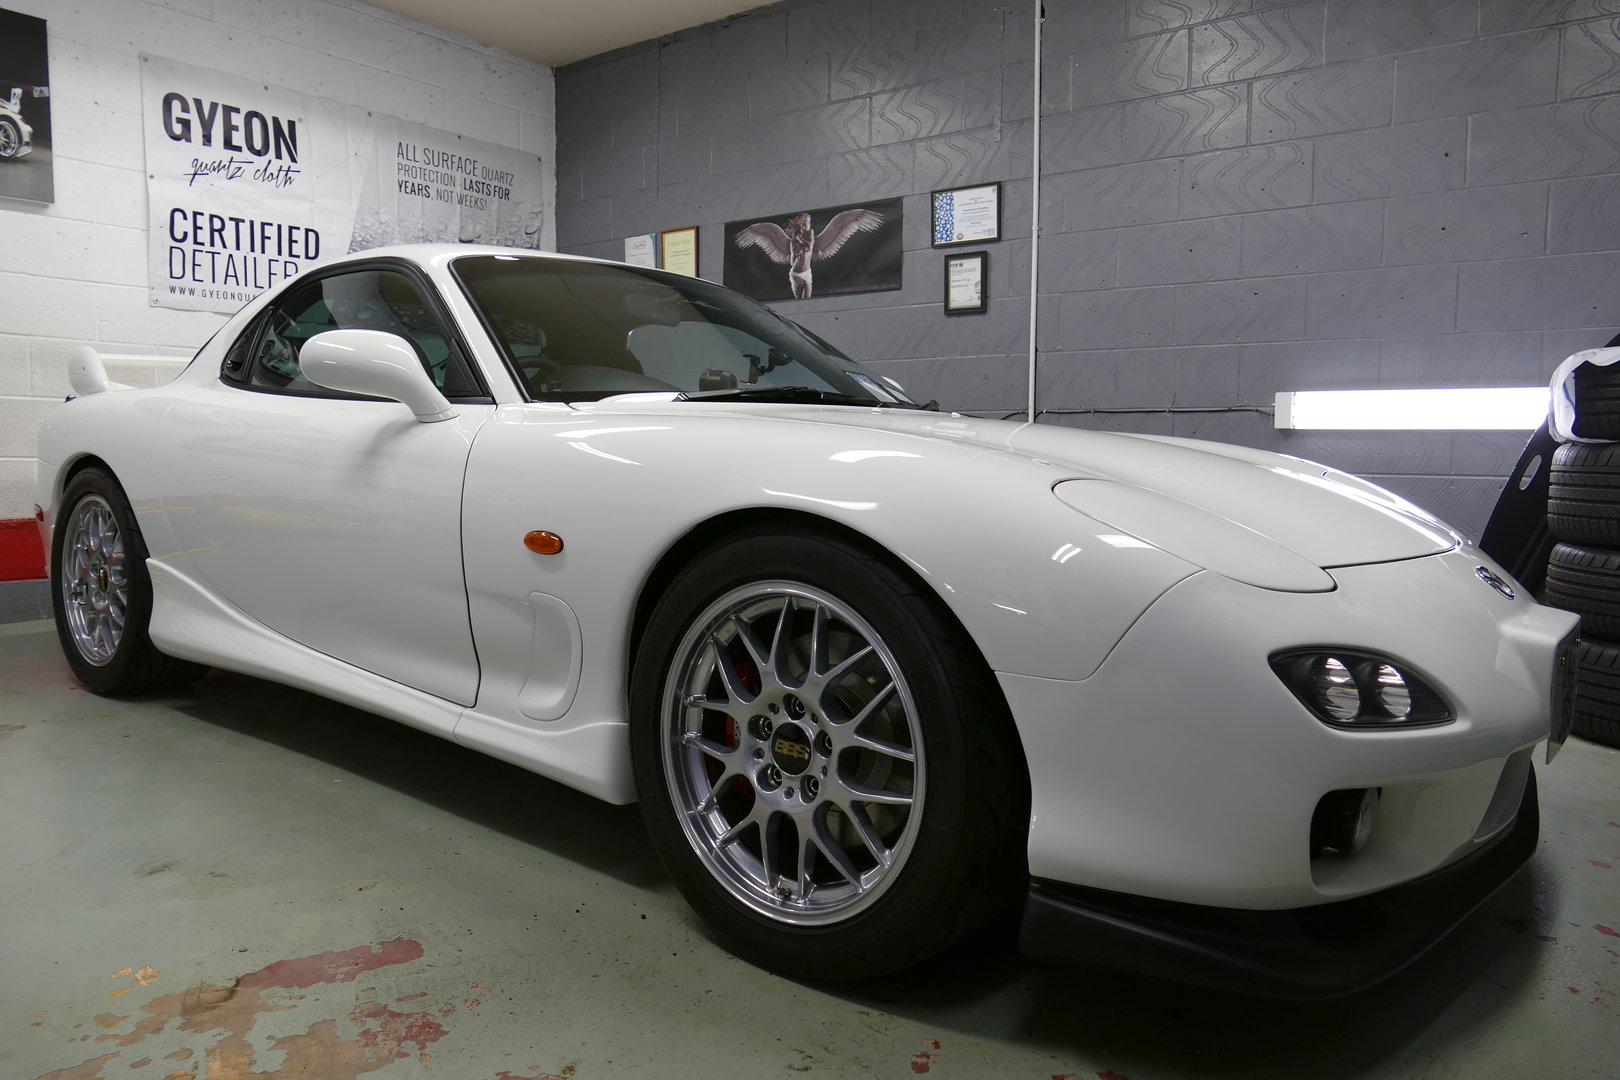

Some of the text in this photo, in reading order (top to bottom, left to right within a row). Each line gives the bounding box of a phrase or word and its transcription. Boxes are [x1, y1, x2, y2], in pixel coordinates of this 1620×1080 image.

[162, 92, 298, 164] GYEON
[183, 156, 301, 188] quartz cloth
[397, 142, 514, 187] ALL SURFACE QUARTZ
[397, 162, 456, 188] PROTECTION
[463, 177, 491, 196] LASTS
[493, 187, 510, 201] FOR
[436, 188, 453, 204] NOT
[456, 193, 487, 212] WEEKS!
[169, 207, 320, 261] CERTIFIED
[774, 738, 811, 760] BBS
